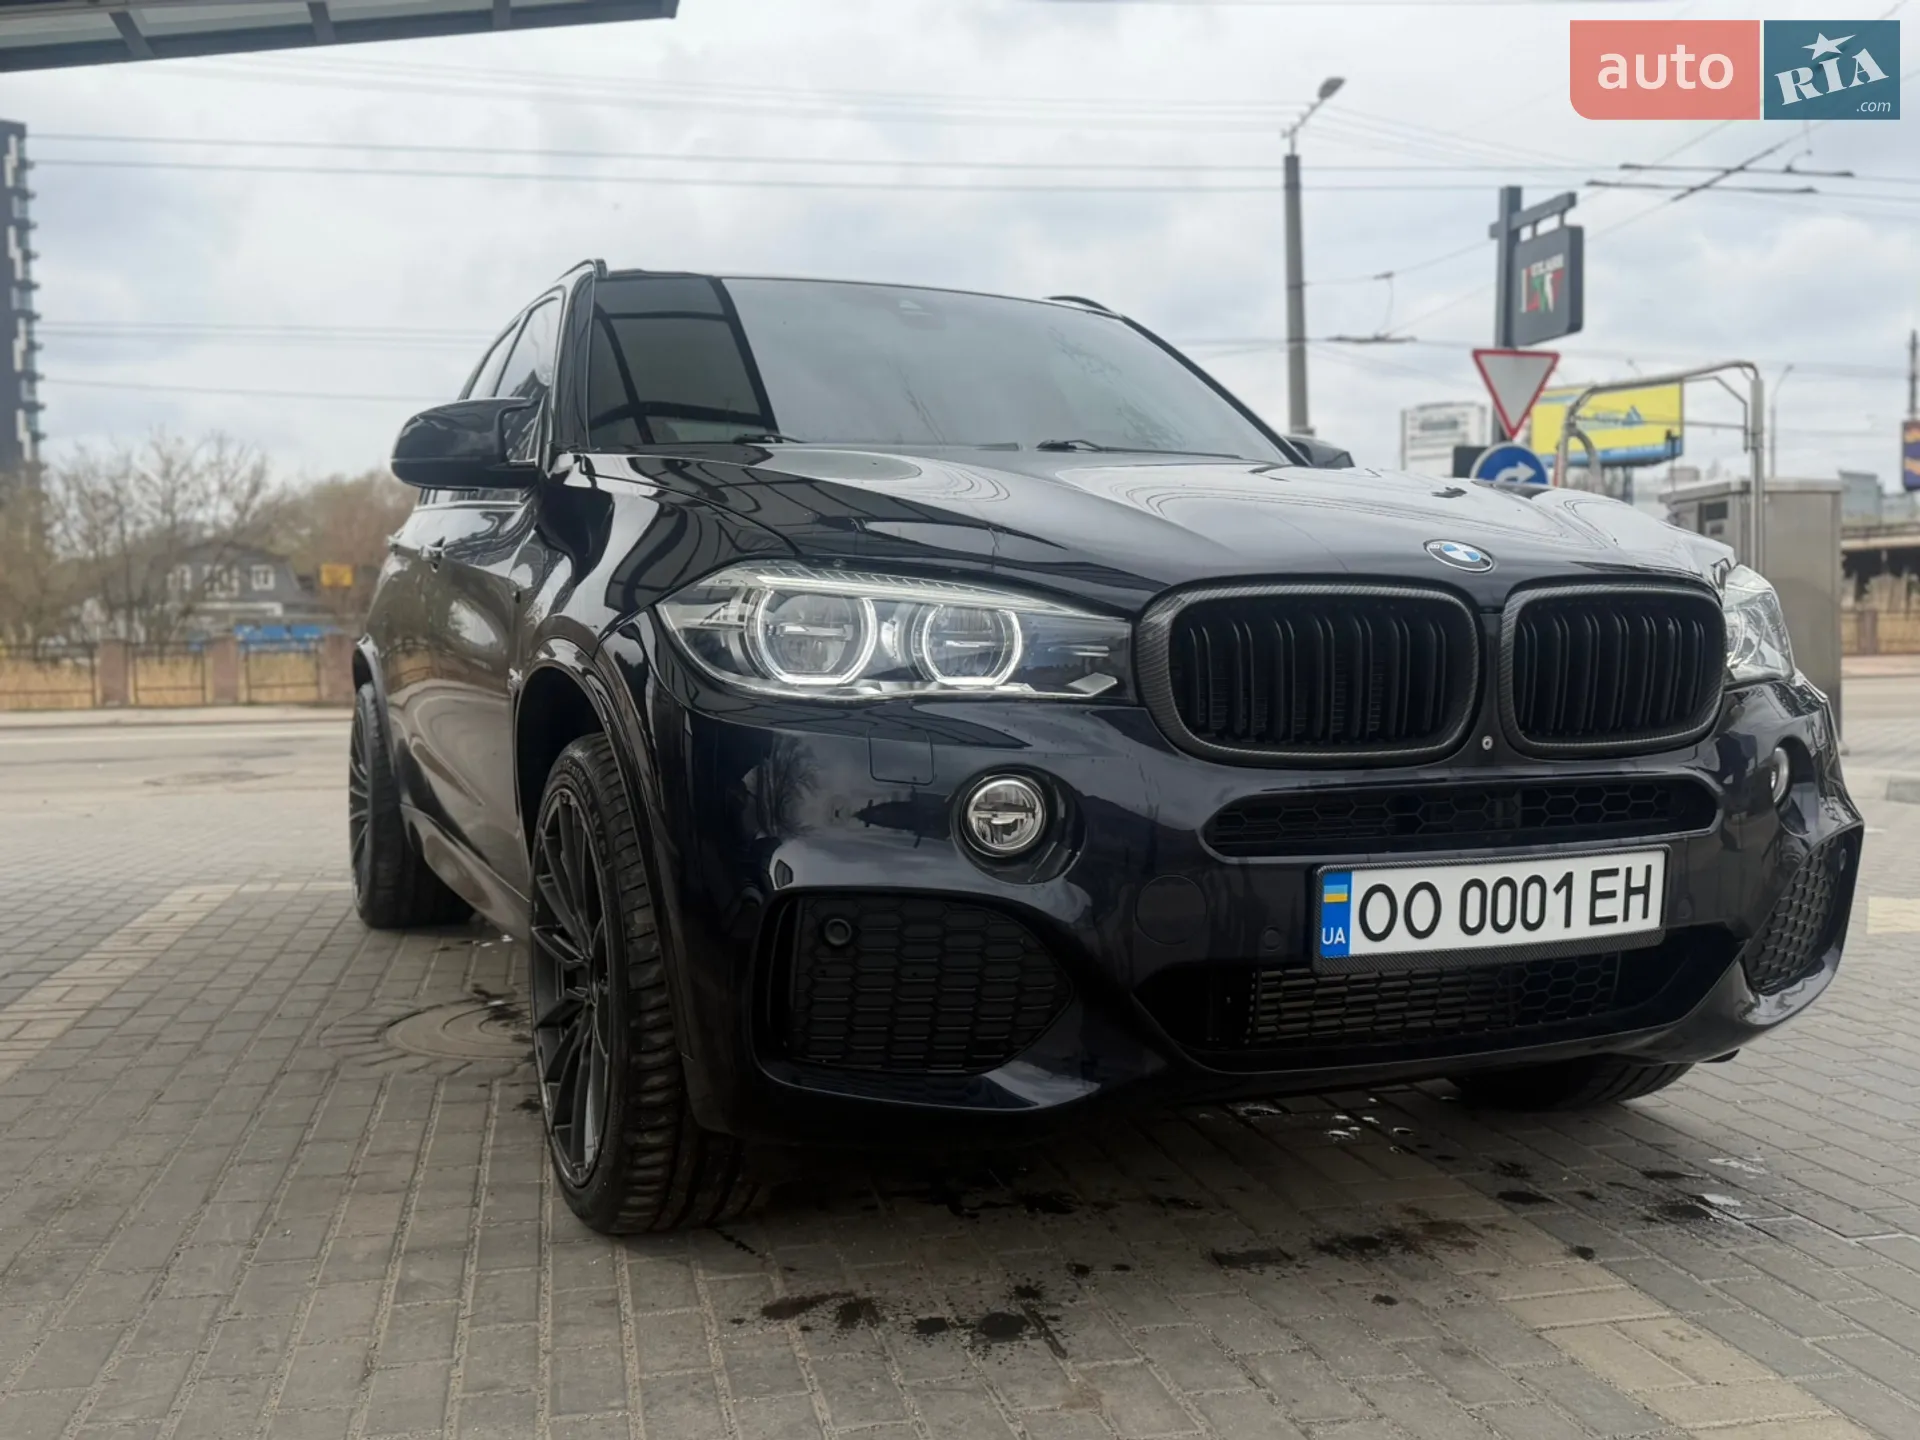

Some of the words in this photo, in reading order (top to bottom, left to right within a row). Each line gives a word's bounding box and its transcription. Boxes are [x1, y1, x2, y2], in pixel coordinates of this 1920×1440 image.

[1358, 881, 1442, 942] OO
[1459, 871, 1574, 936] 0001
[1589, 863, 1652, 926] EH
[1321, 926, 1347, 945] UA
